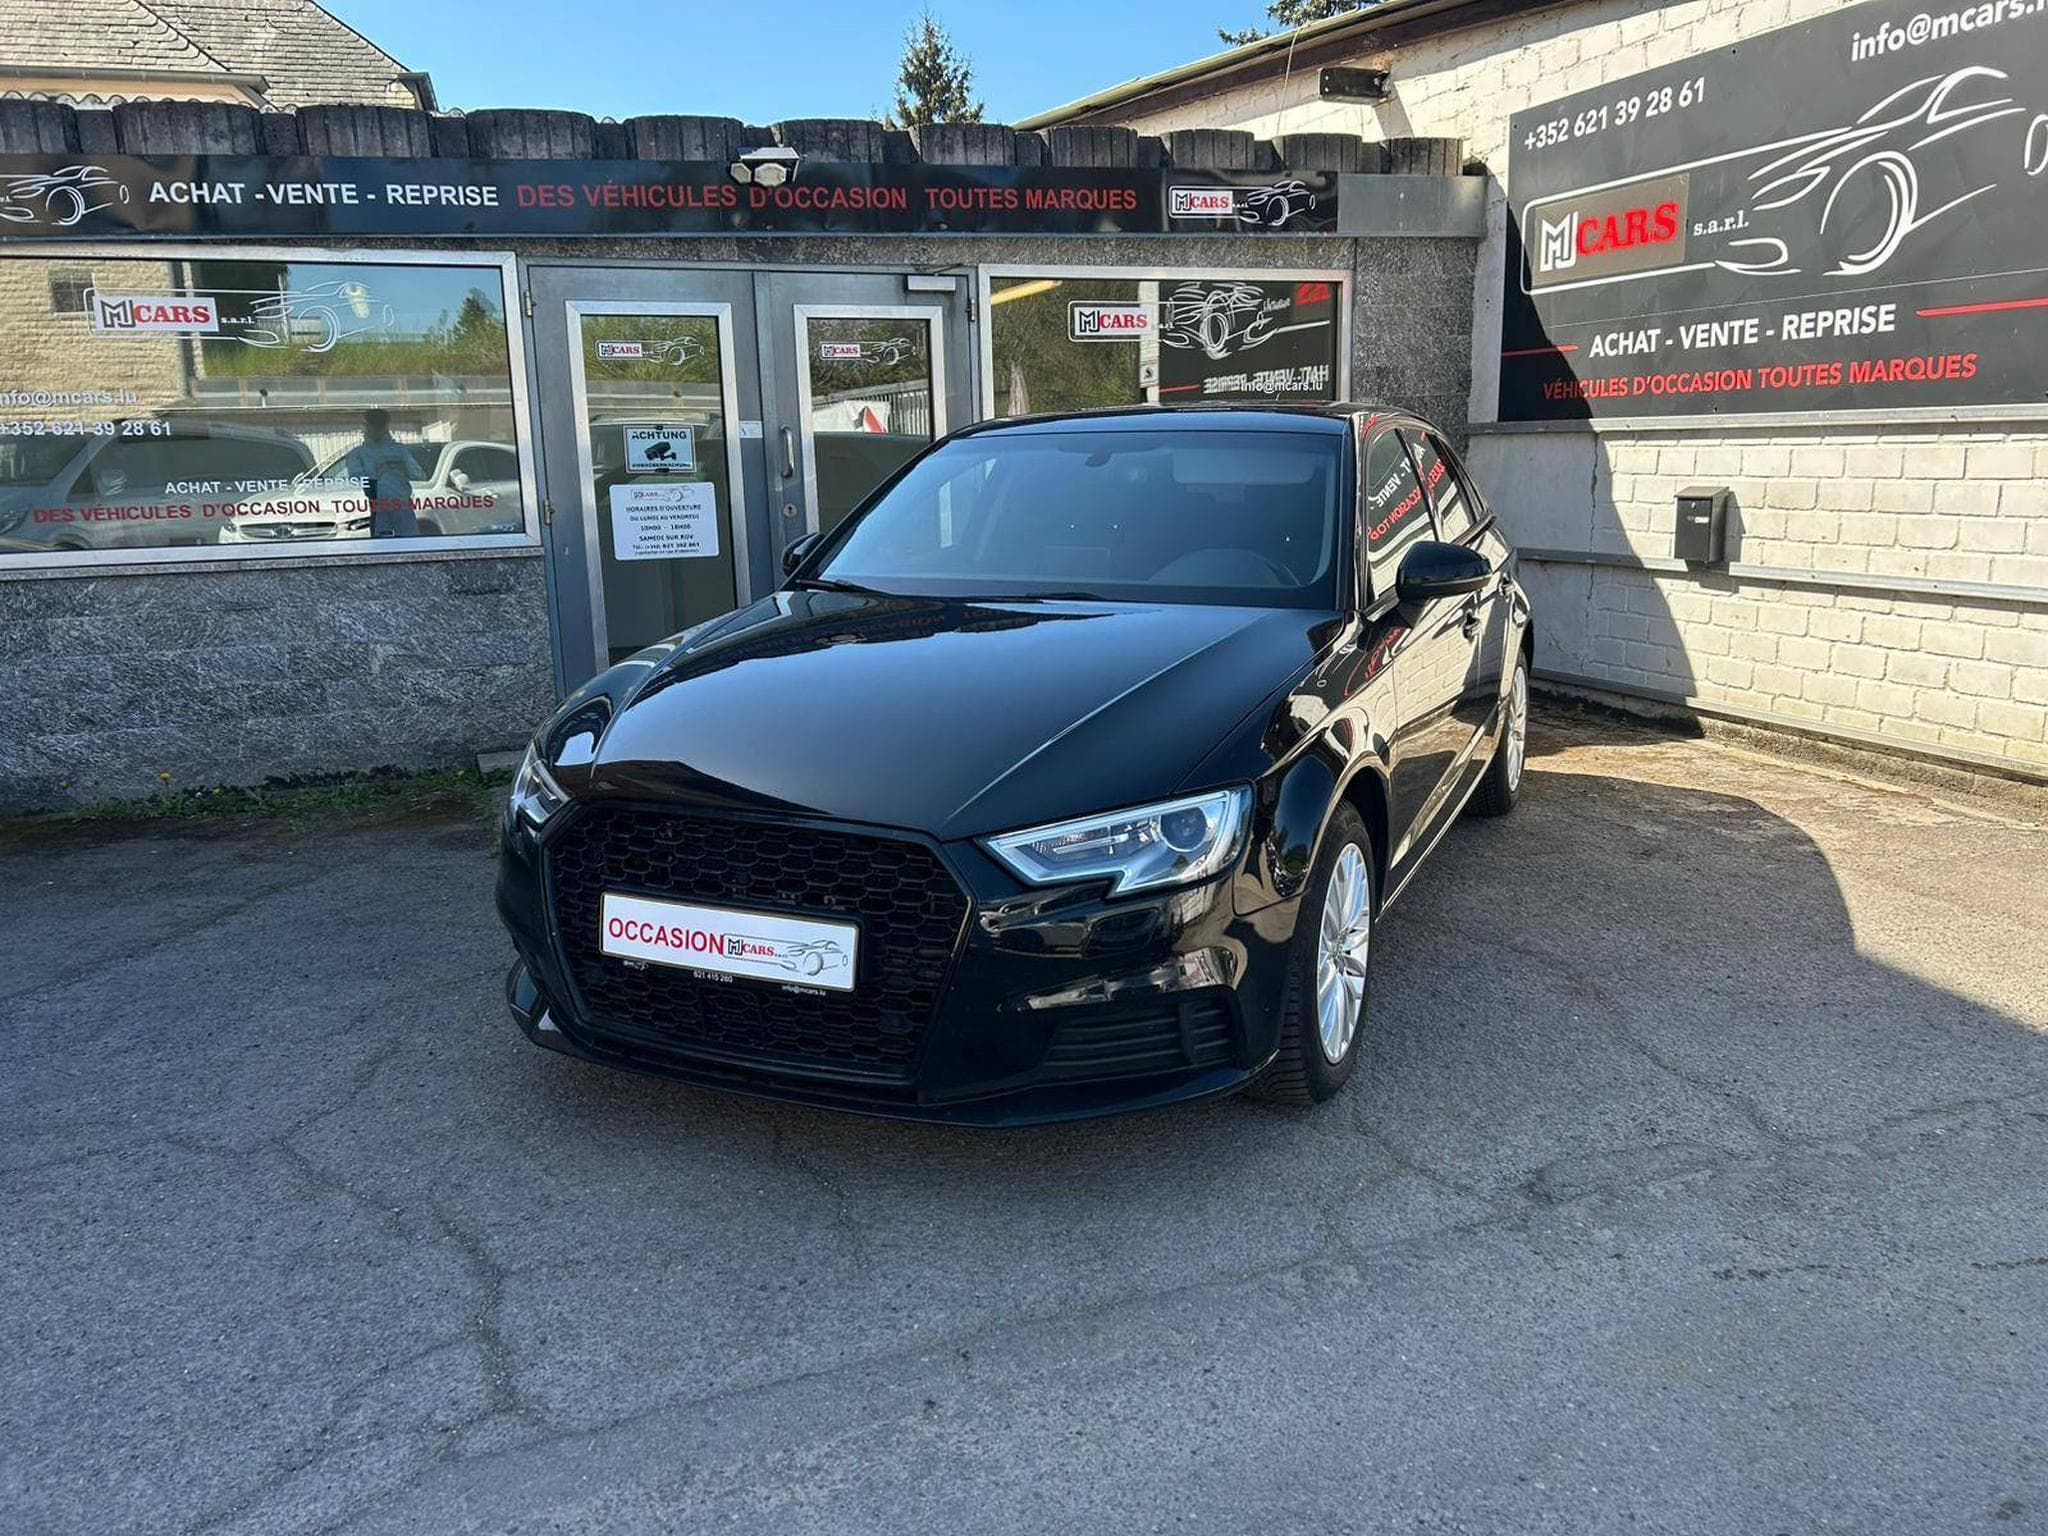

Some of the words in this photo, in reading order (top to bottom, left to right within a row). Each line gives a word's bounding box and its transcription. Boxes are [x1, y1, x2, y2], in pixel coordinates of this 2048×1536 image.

[1524, 117, 1569, 150] +352
[1574, 105, 1608, 138] 621
[1614, 96, 1641, 126] 39
[1645, 86, 1673, 118] 28
[1678, 76, 1706, 108] 61
[149, 182, 245, 204] ACHAT
[386, 184, 500, 206] REPRISE
[516, 184, 575, 208] DES
[581, 179, 738, 208] VÉHICULES
[750, 187, 907, 210] D'OCCASION
[924, 187, 1018, 209] TOUTES
[1025, 188, 1138, 210] MARQUES
[1693, 210, 1750, 237] s.a.r.l.
[1588, 328, 1661, 358] ACHAT
[1679, 318, 1760, 350] VENTE
[1782, 303, 1897, 341] REPRISE
[1240, 379, 1323, 393] info@mcars.lu
[1543, 376, 1628, 400] VÉHICULES
[1633, 368, 1752, 396] D'OCCASION
[1758, 362, 1843, 389] TOUTES
[1850, 353, 1978, 384] MARQUES
[0, 389, 138, 407] nfo@mcars.lu
[52, 422, 85, 436] 621
[95, 421, 115, 436] 39
[121, 421, 145, 436] 28
[150, 421, 171, 436] 61
[631, 431, 687, 440] ACHTUNG
[165, 482, 220, 494] ACHAT
[234, 480, 288, 493] VENTE
[33, 509, 74, 523] DES
[80, 504, 191, 522] VÉHICULES
[203, 500, 320, 518] D'OCCASION
[334, 499, 399, 513] TOUTES
[409, 495, 494, 511] MARQUES
[608, 918, 725, 955] OCCASION
